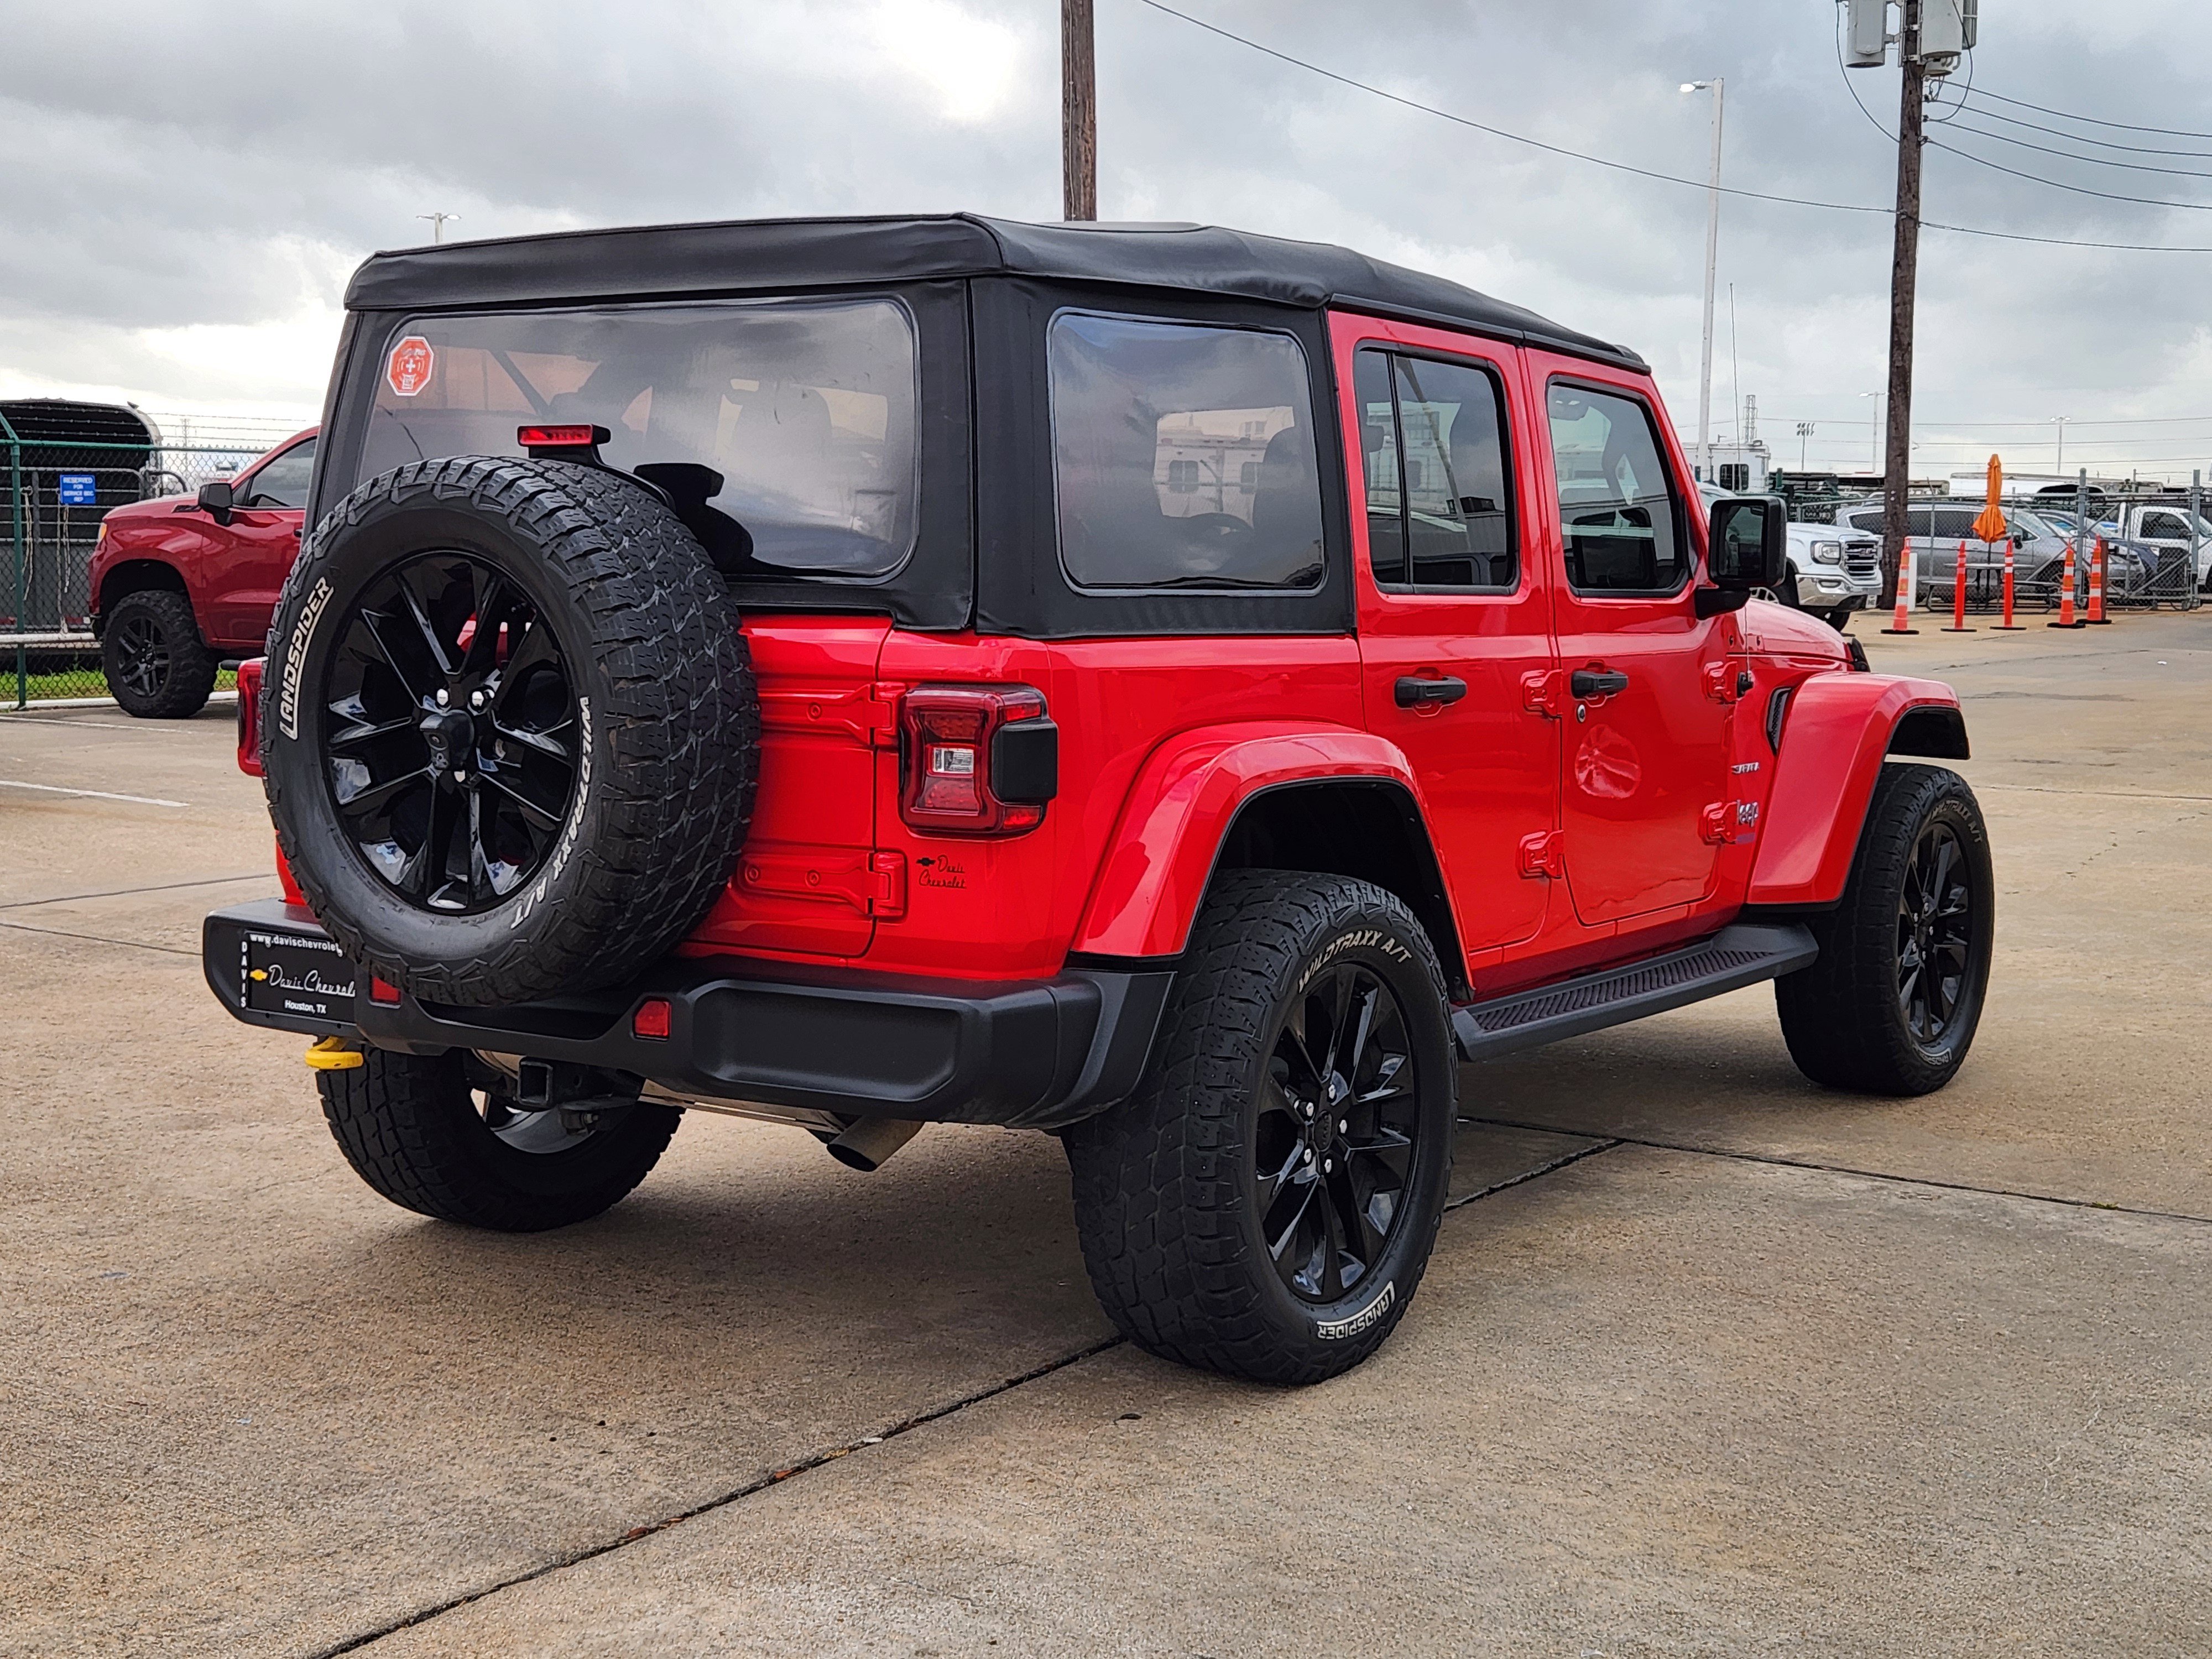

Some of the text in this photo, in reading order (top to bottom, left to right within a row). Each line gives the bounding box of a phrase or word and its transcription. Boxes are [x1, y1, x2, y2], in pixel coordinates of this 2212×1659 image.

[279, 576, 334, 740] LANDSPIDER
[510, 696, 591, 930] WILDTRAXX A/T
[269, 964, 304, 990] Davis
[1297, 930, 1412, 994] WILDTRAXX A/T
[284, 999, 327, 1014] Houston, TX
[1316, 1280, 1395, 1340] LANDSPIDER
